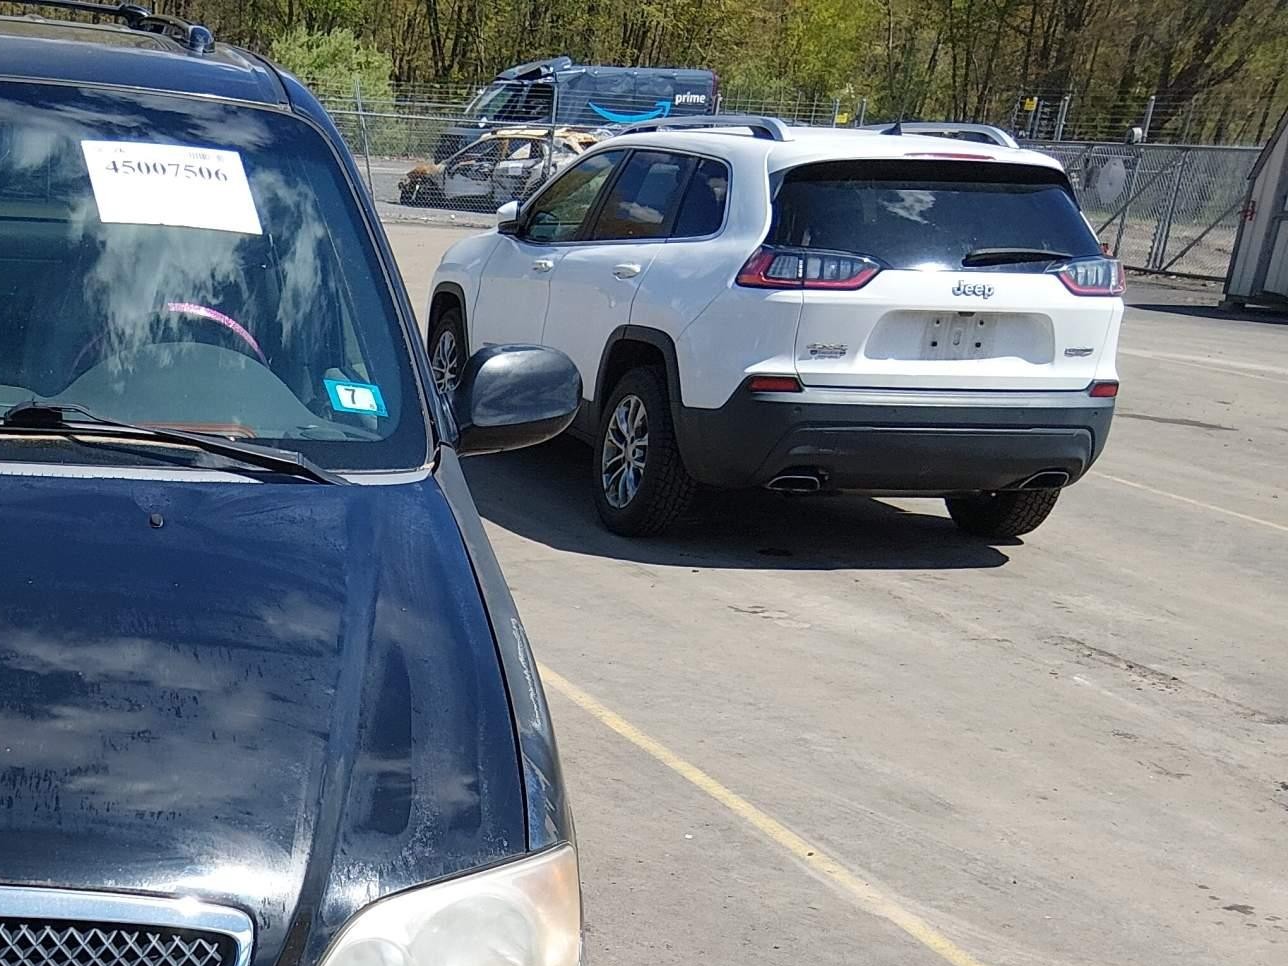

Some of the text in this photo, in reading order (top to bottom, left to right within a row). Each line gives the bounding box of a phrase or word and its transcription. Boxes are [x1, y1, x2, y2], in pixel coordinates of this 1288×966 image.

[675, 91, 706, 105] prime
[105, 160, 229, 183] 45007506
[952, 280, 994, 299] Jeep
[344, 388, 356, 405] 7
